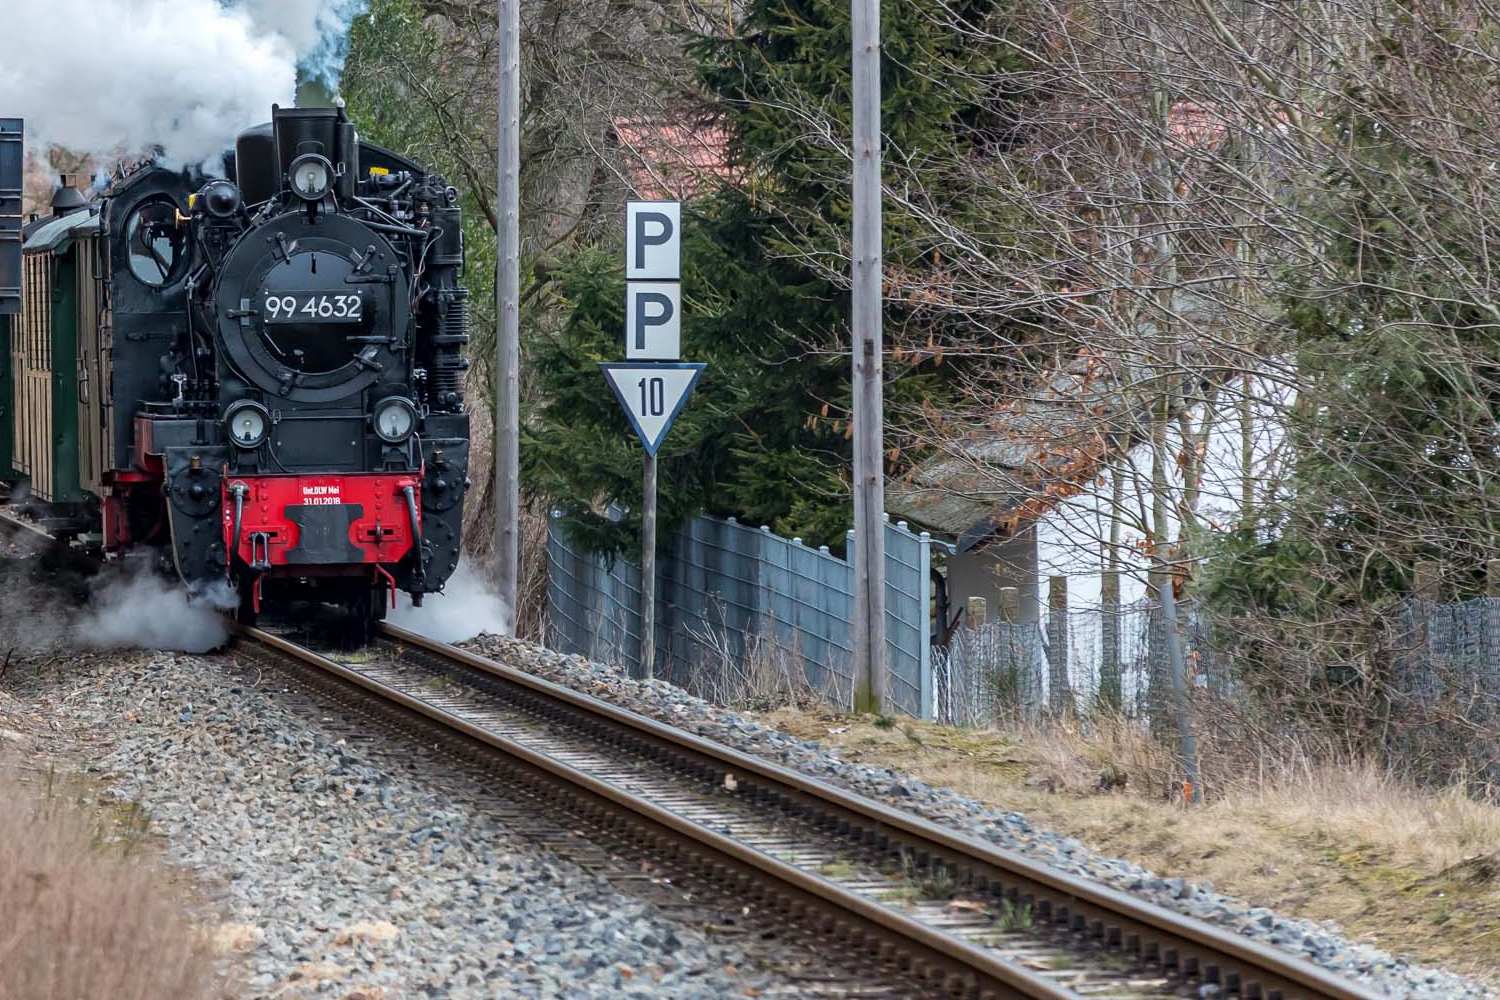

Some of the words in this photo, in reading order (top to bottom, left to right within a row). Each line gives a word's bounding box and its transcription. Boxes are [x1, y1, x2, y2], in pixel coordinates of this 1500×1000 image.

[635, 212, 674, 270] P
[265, 296, 297, 319] 99
[300, 295, 361, 318] 4632
[635, 292, 674, 350] P
[638, 377, 665, 417] 10
